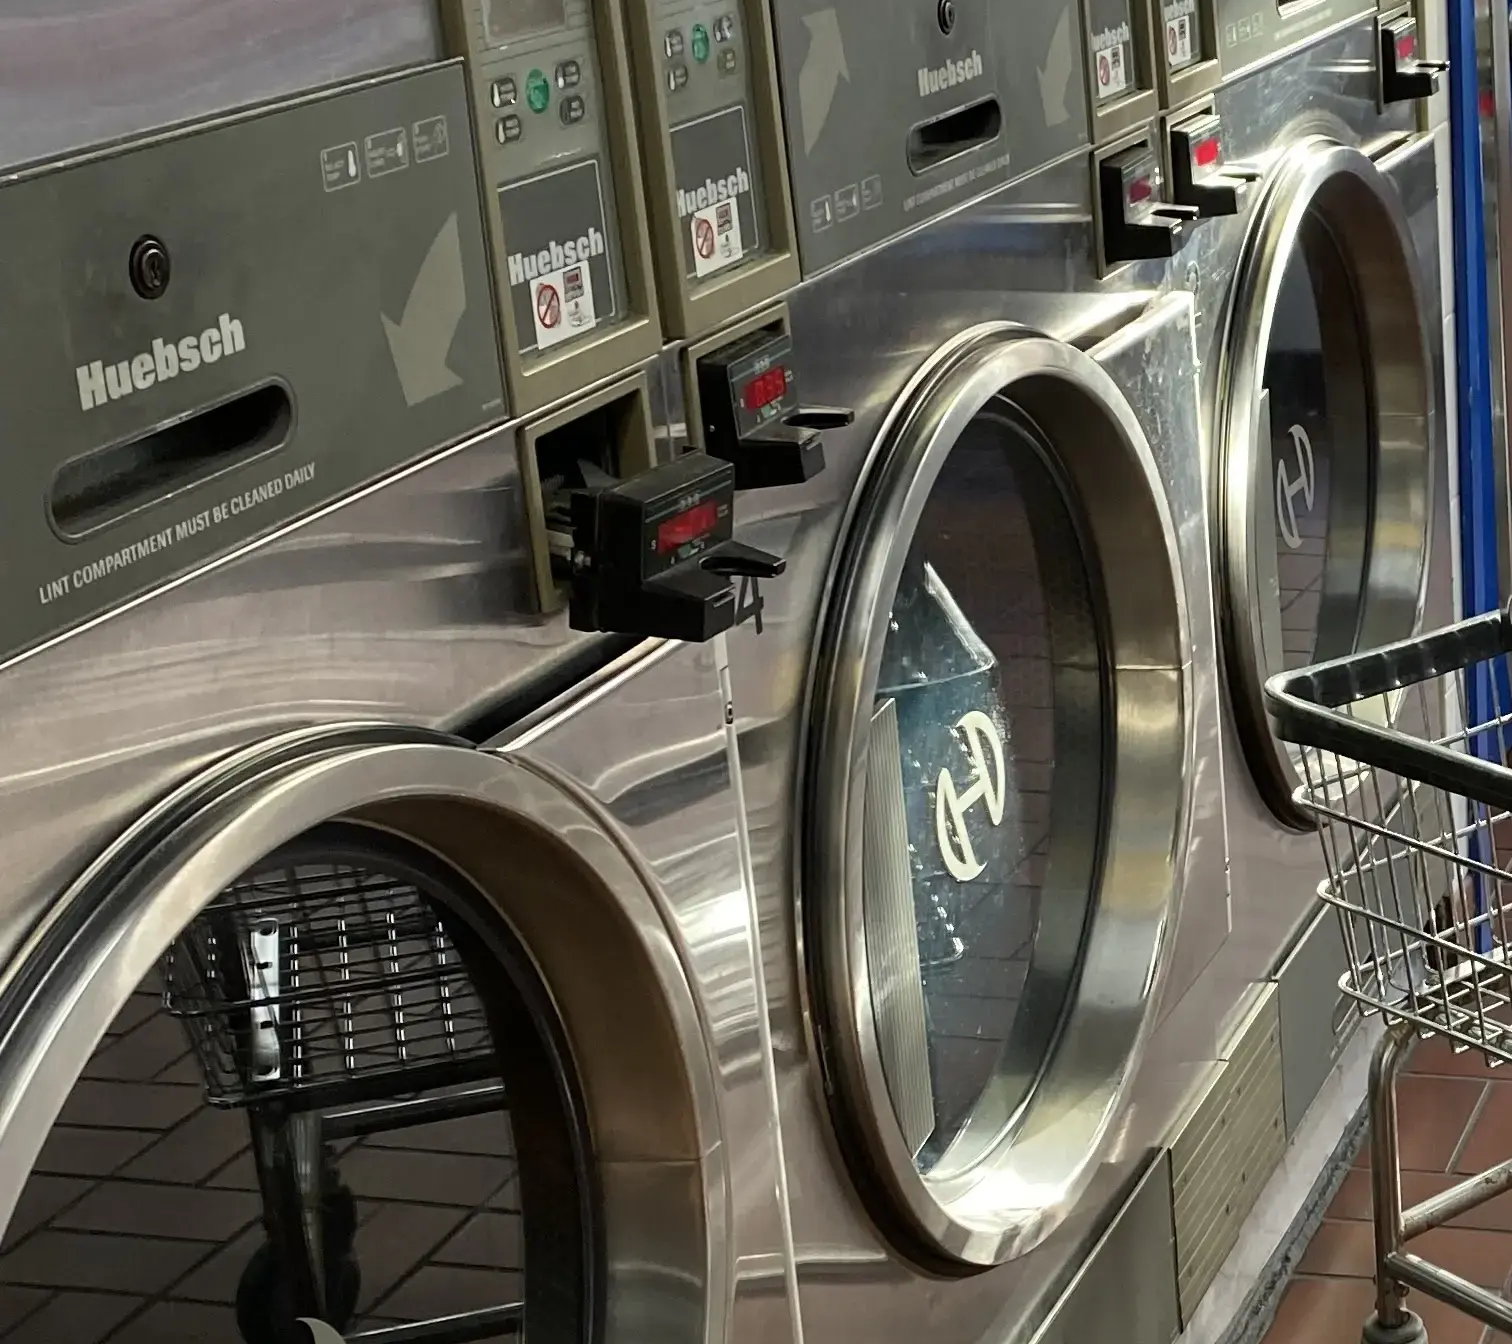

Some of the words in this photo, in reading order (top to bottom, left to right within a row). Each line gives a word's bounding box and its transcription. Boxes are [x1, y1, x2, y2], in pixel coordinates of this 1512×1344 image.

[917, 49, 983, 97] Huebsch
[507, 226, 604, 286] Huebsch
[75, 312, 247, 412] Huebsch
[39, 574, 70, 604] LINT
[72, 527, 173, 588] COMPARTMENT
[175, 510, 210, 541] MUST
[212, 502, 229, 523] BE
[230, 477, 283, 515] CLEANED
[284, 461, 316, 490] DAILY
